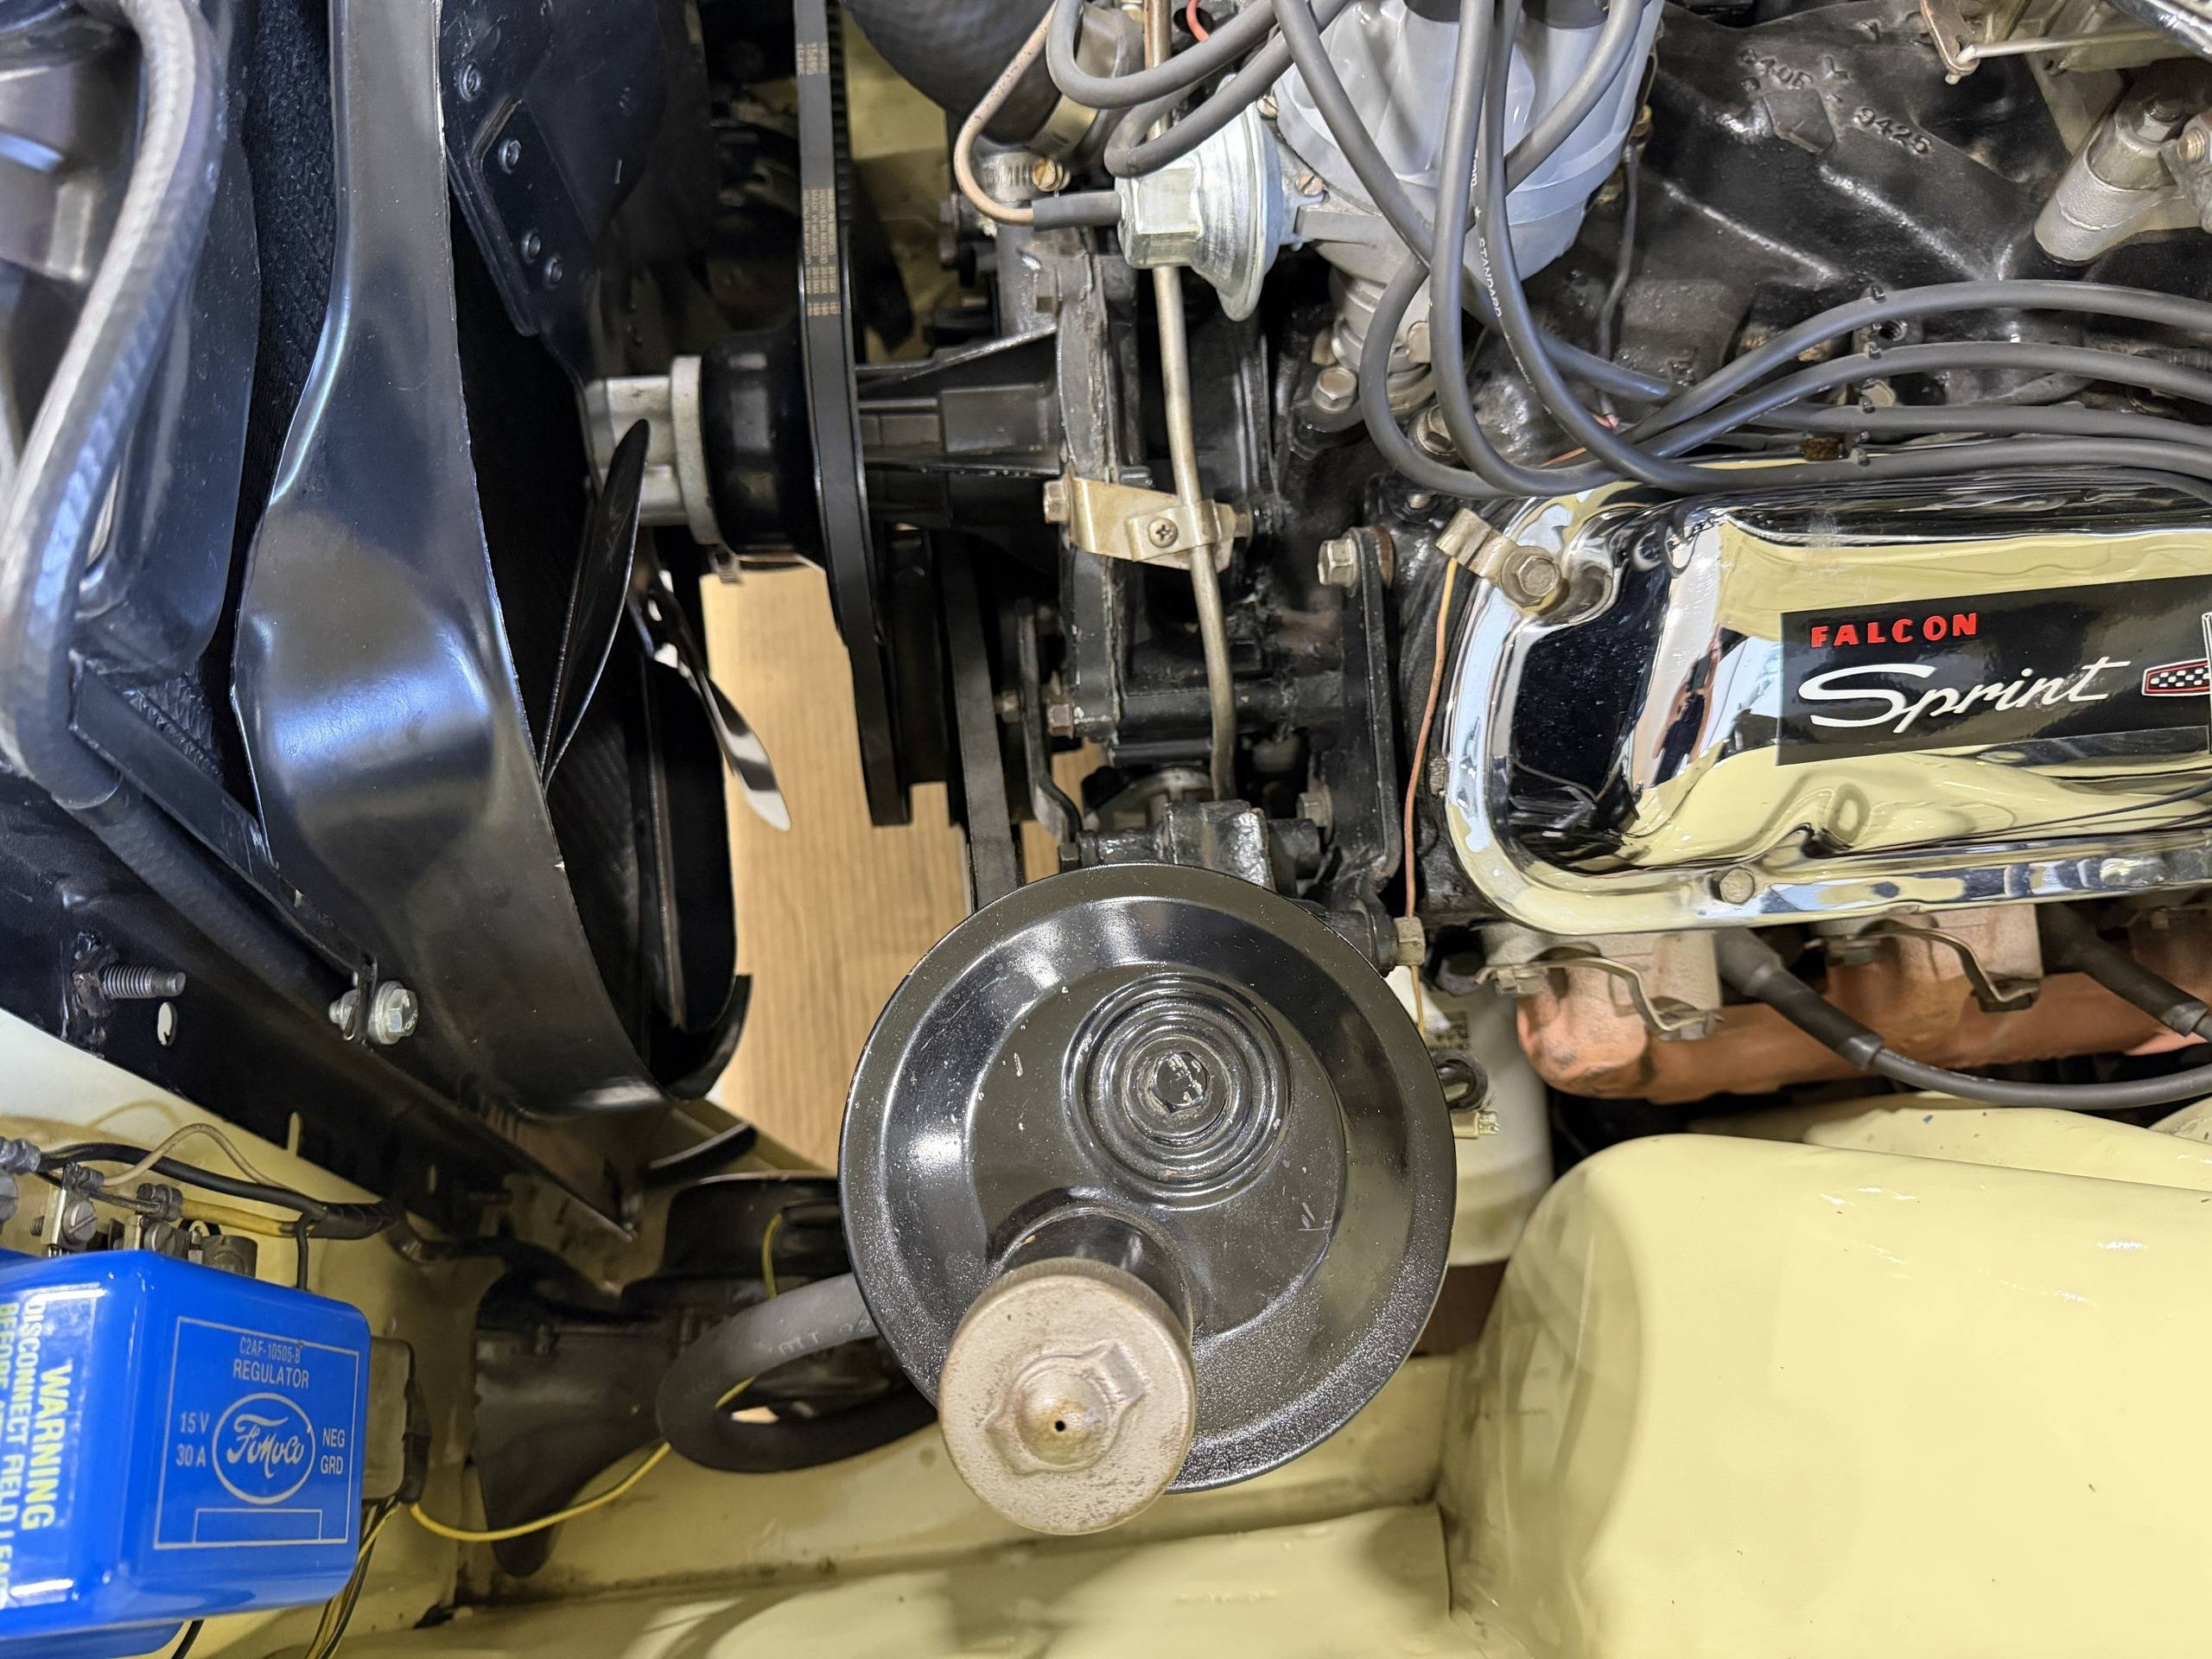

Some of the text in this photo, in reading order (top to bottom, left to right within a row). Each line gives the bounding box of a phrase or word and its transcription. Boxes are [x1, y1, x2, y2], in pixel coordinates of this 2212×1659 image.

[1853, 106, 1934, 156] 9425
[1811, 613, 1978, 648] FALCON
[1798, 656, 2132, 734] Sprint
[239, 1337, 302, 1363] C2AF-10505-B
[6, 1295, 46, 1446] DISCONNECT
[233, 1358, 310, 1389] REGULATOR
[180, 1411, 210, 1434] 15 V
[322, 1428, 346, 1448] NEG
[21, 1357, 73, 1530] WARNING
[176, 1444, 207, 1468] 30 A
[226, 1414, 305, 1478] FoMoCo
[321, 1455, 344, 1475] GRD
